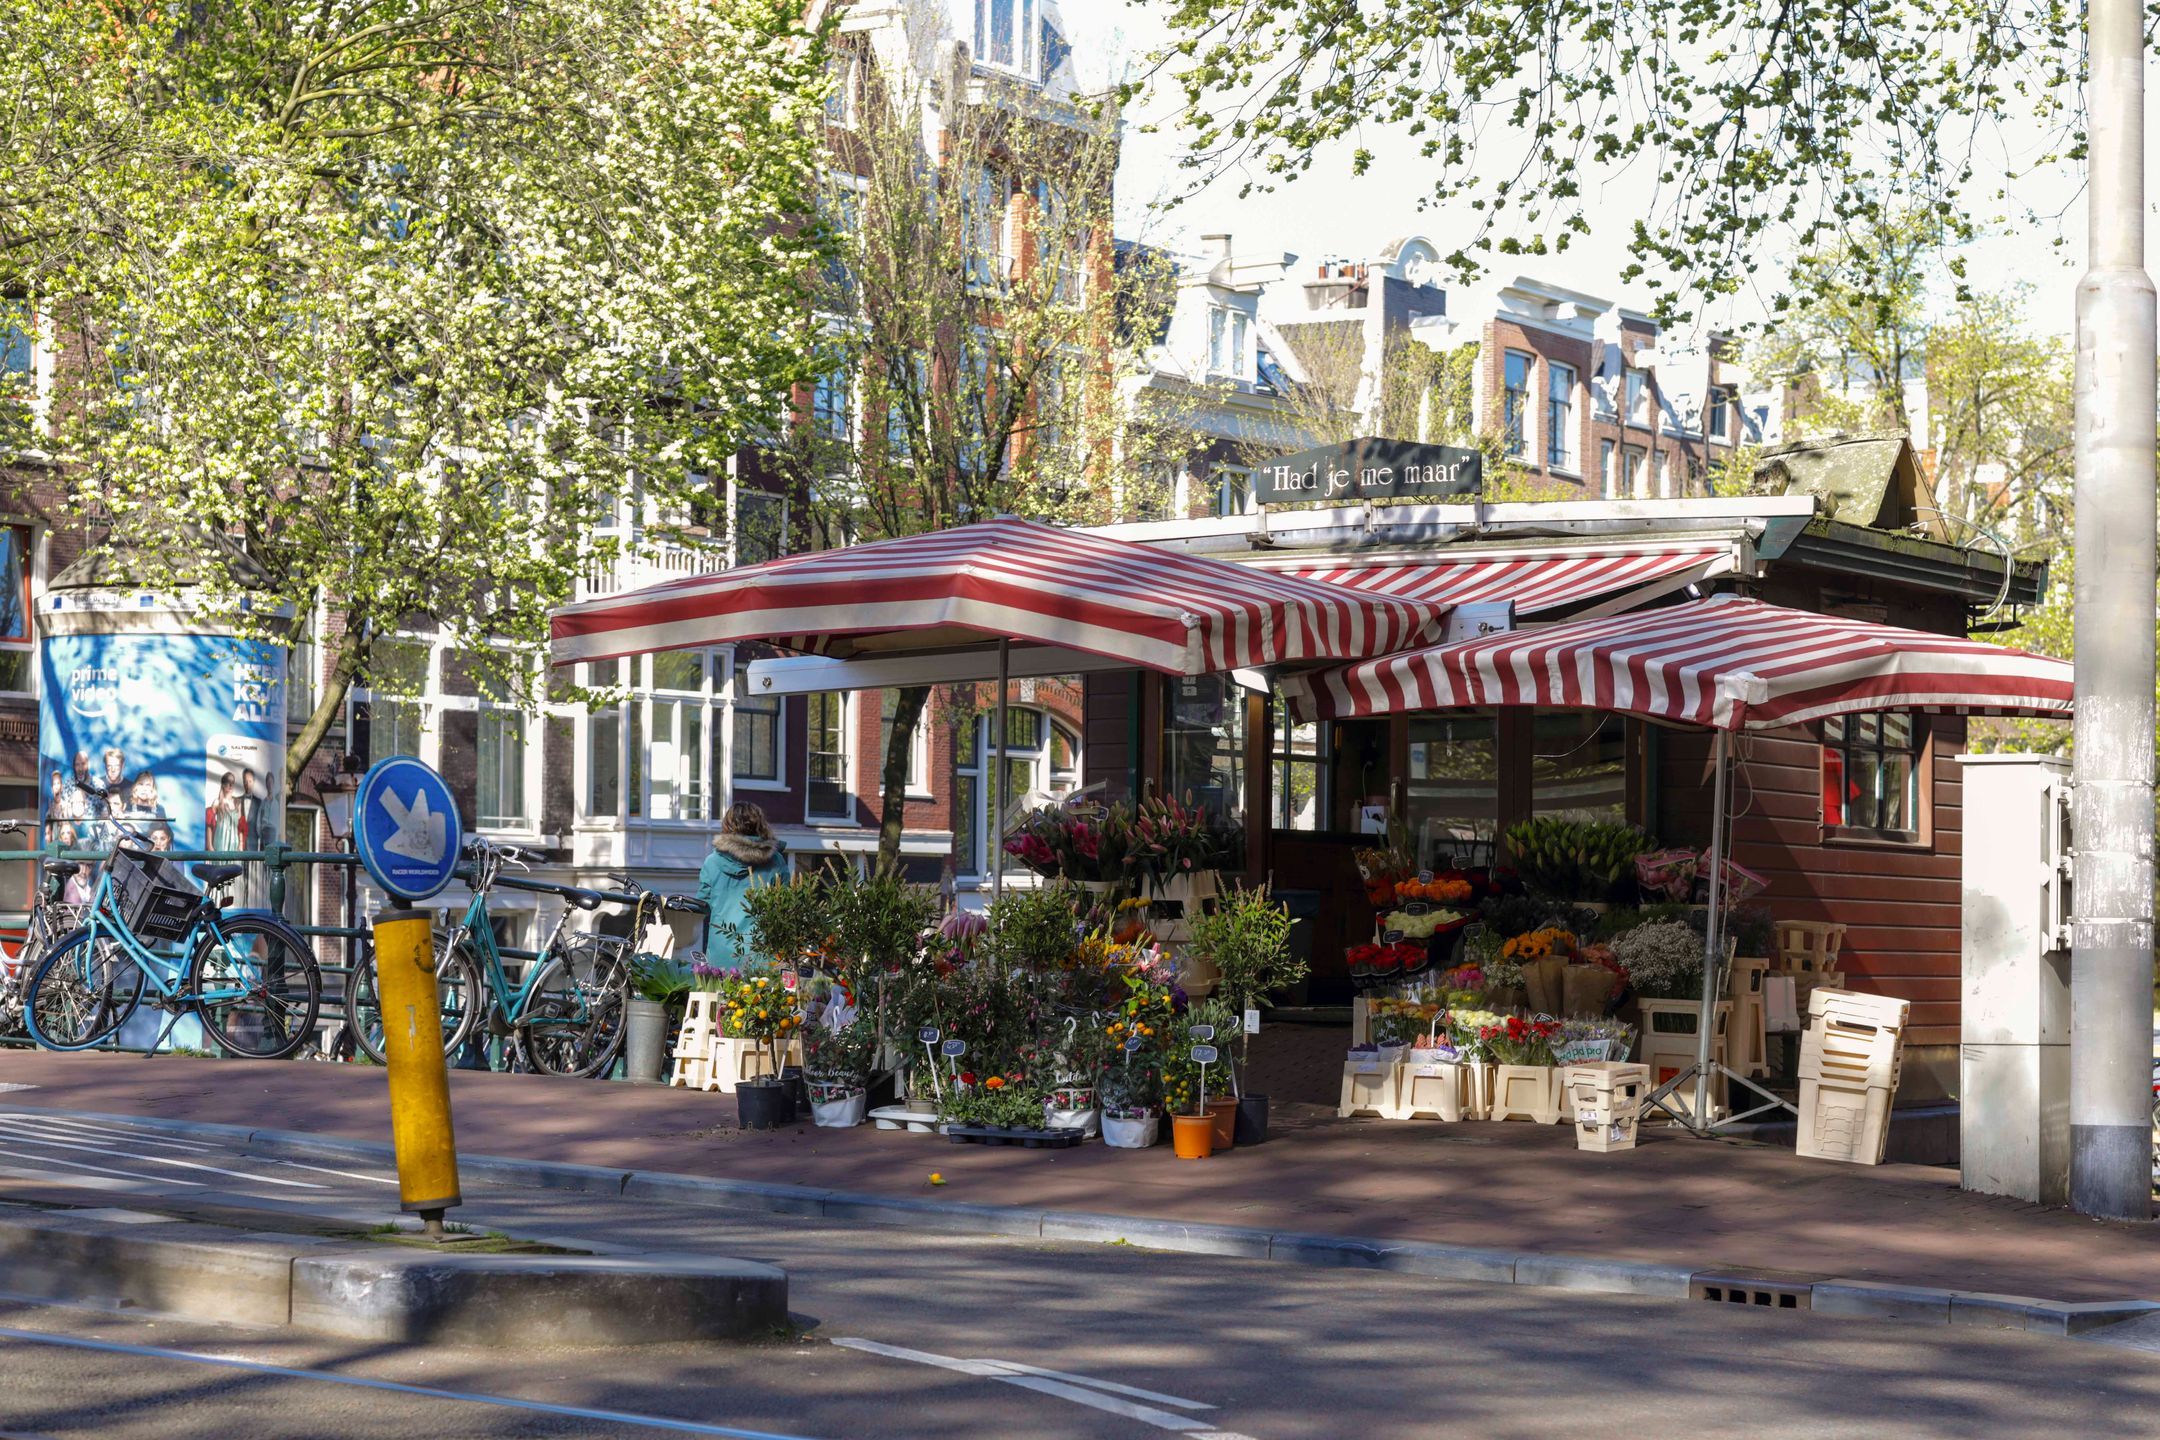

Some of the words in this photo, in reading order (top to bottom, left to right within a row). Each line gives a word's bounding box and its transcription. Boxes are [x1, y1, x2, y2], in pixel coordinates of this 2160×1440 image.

[1324, 464, 1350, 497] je
[1360, 466, 1393, 487] me
[72, 664, 116, 686] prime
[72, 683, 117, 702] video
